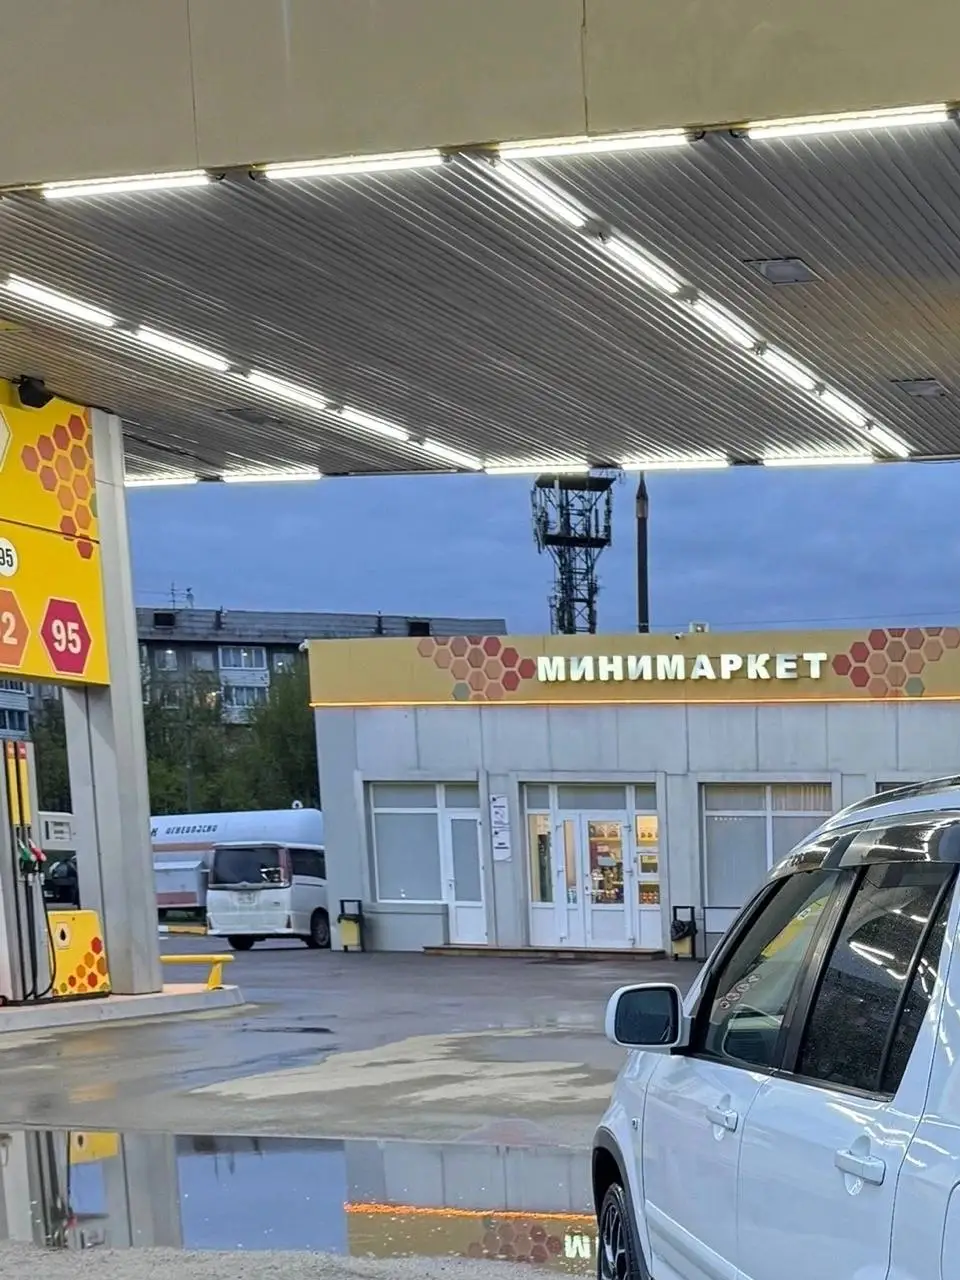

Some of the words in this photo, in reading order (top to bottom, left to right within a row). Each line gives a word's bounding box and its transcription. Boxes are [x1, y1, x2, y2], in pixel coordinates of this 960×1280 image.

[0, 611, 18, 645] 2
[51, 619, 82, 654] 95
[537, 652, 828, 682] МИНИМАРКЕТ
